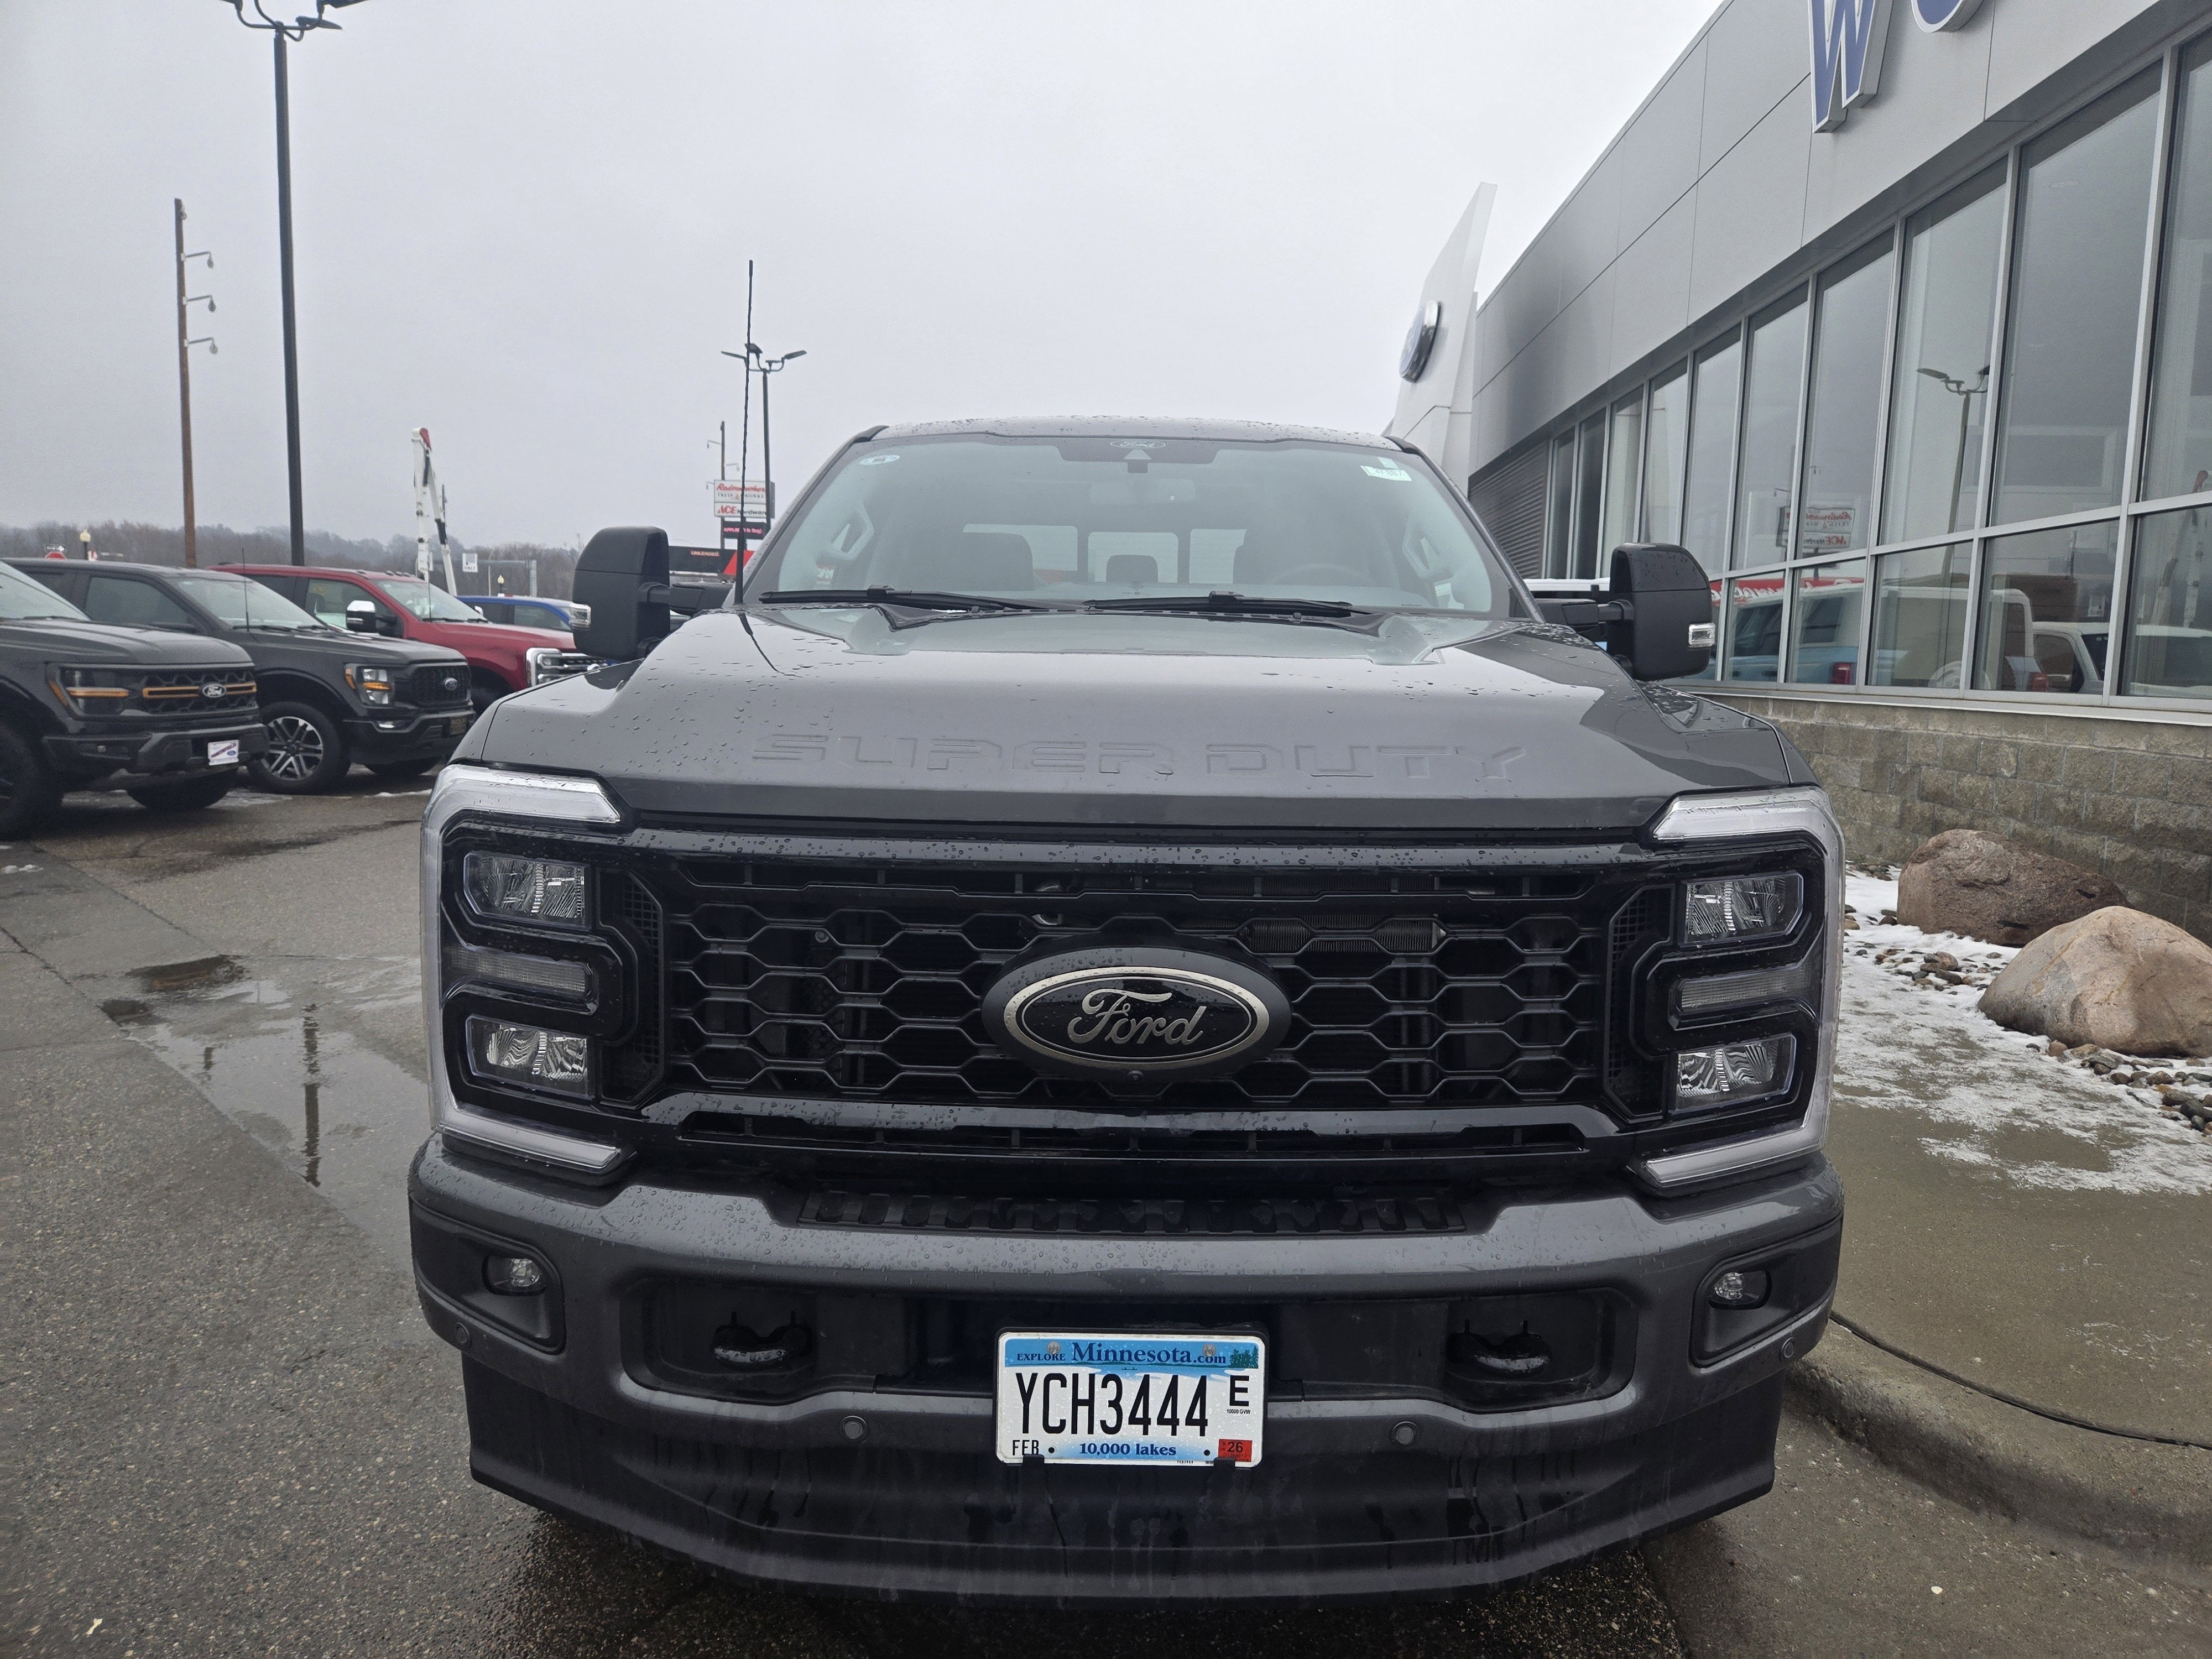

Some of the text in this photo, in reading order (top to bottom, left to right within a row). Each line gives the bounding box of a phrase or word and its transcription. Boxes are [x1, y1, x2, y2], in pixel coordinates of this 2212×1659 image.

[717, 504, 737, 514] ACE
[750, 733, 1527, 780] SUPER DUTY
[1067, 988, 1207, 1045] Ford
[1017, 1353, 1066, 1361] EXPLORE
[1229, 1375, 1250, 1407] E
[1015, 1372, 1208, 1437] YCH3444
[1012, 1439, 1040, 1455] FEB
[1079, 1443, 1177, 1456] 10,000 lakes
[1227, 1441, 1243, 1453] 26
